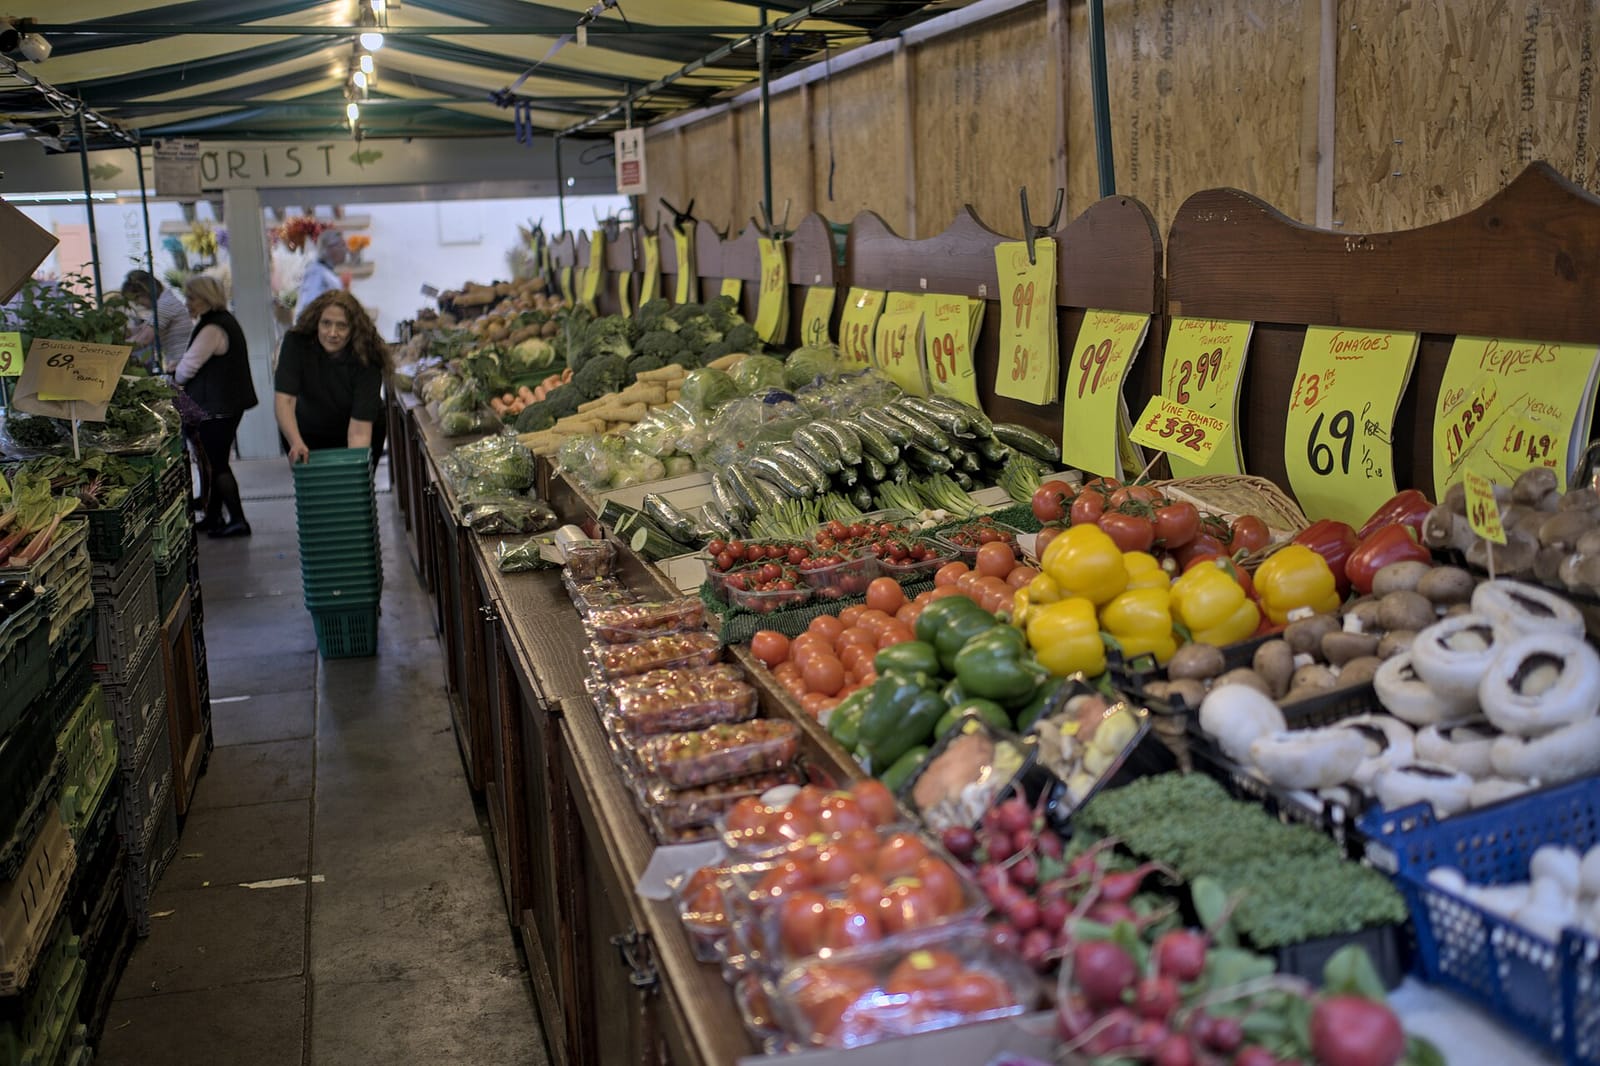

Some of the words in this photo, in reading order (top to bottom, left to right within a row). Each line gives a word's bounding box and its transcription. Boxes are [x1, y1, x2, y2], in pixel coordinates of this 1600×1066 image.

[200, 144, 335, 182] ORIST
[1012, 281, 1034, 329] 99
[1329, 331, 1392, 355] TOMATOES
[1479, 338, 1561, 377] PEPPERS
[1078, 338, 1112, 399] 99
[1161, 400, 1183, 418] VINE
[1291, 372, 1320, 411] £3
[1307, 409, 1355, 476] 69
